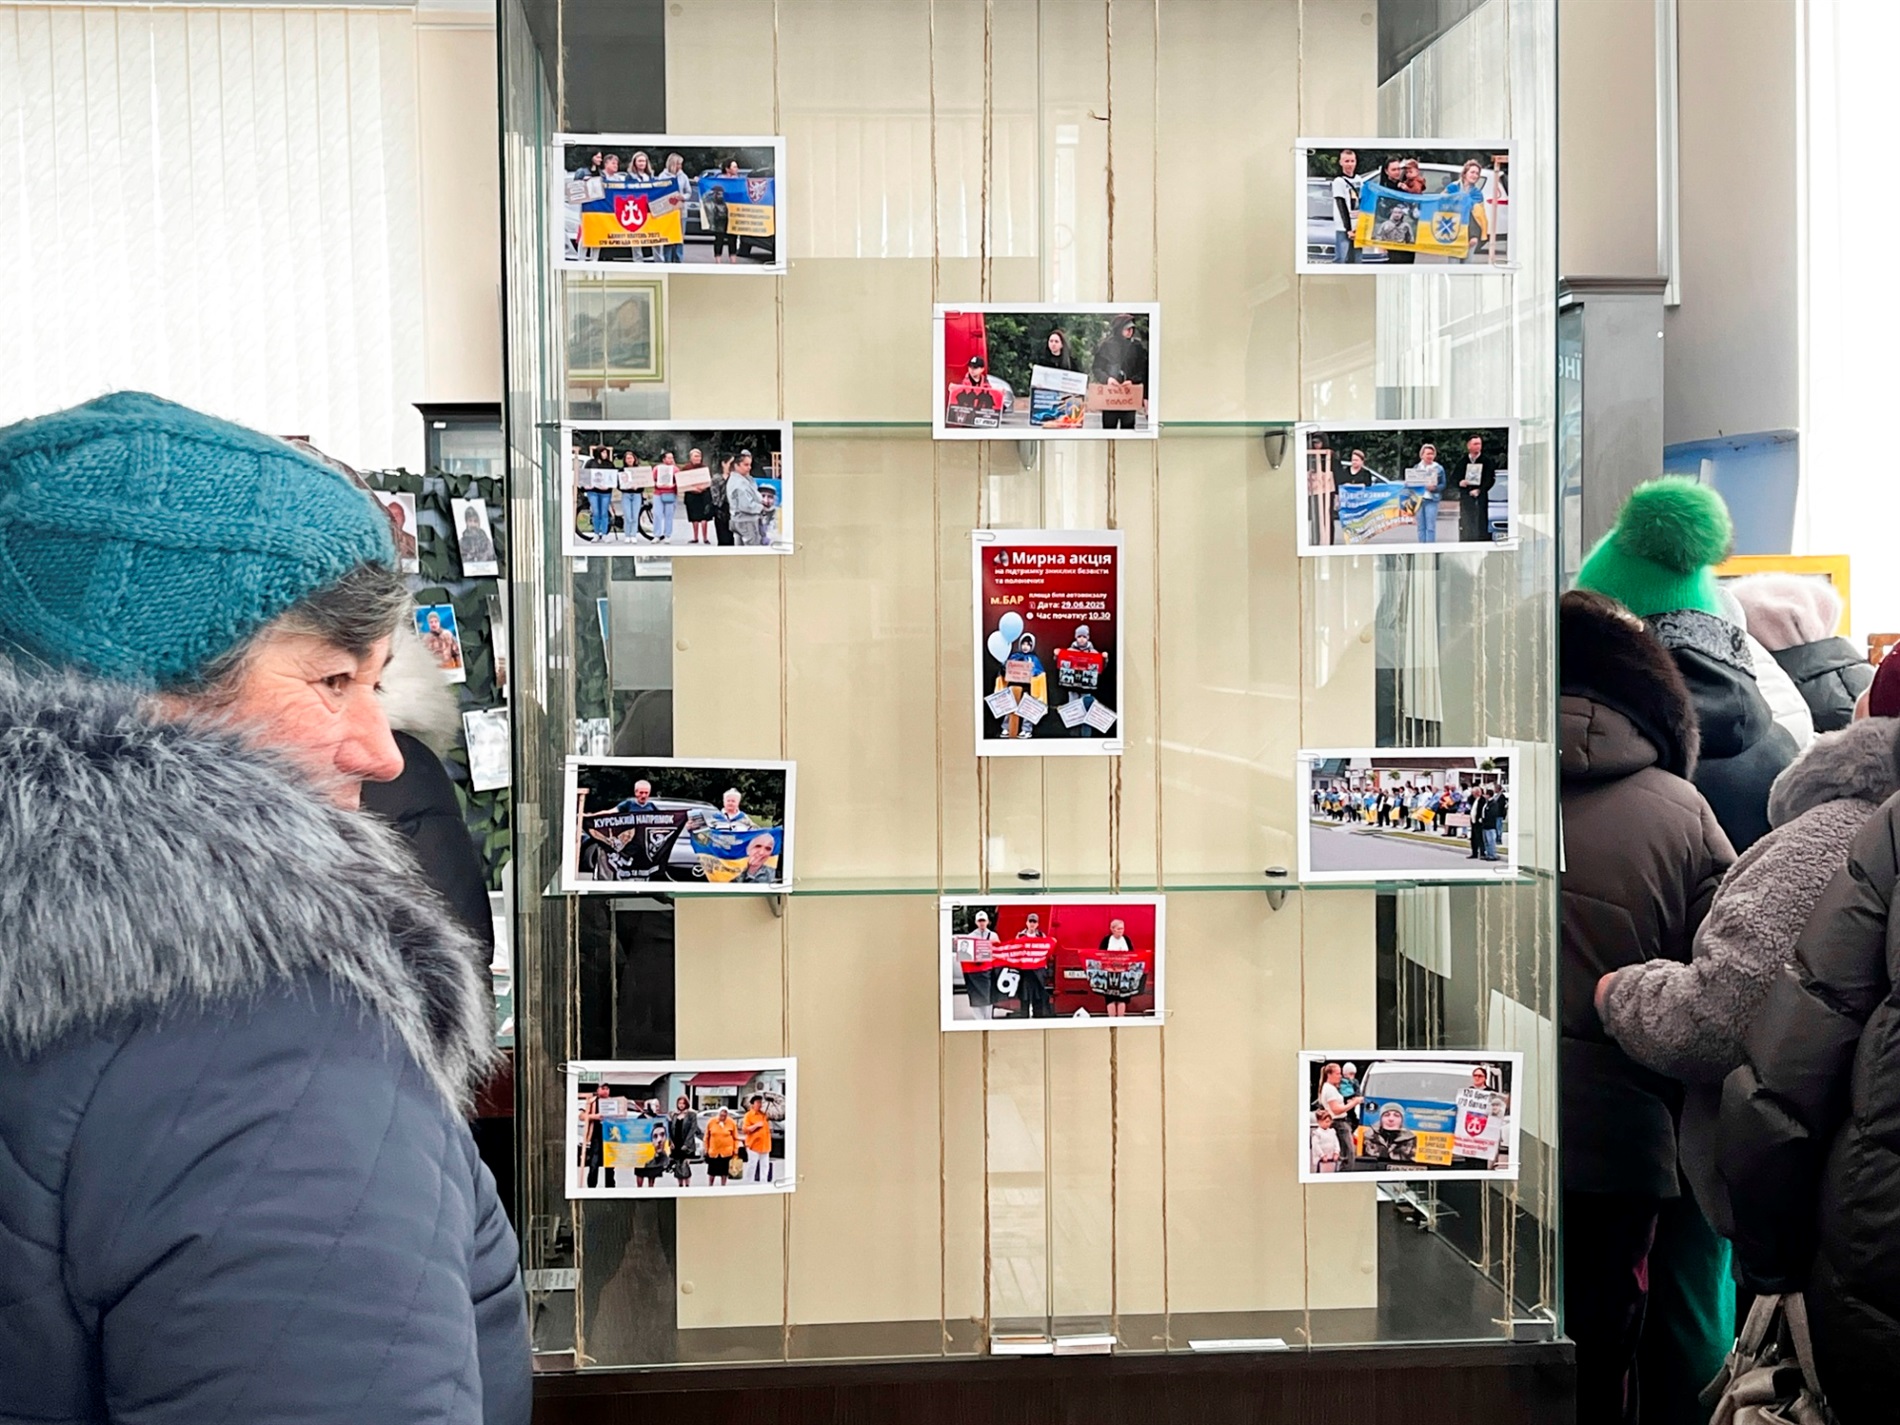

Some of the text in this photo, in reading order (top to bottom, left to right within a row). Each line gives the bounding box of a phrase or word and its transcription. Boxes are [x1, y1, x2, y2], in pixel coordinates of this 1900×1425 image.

[1012, 552, 1112, 567] Мирна акція
[1005, 568, 1044, 576] підтримку
[1077, 567, 1110, 575] безвісти
[990, 595, 1024, 605] м.БАР
[1037, 601, 1060, 610] Дата:
[1036, 612, 1111, 621] Час початку: 10.30
[593, 814, 675, 828] КУРСЬКИЙ НАПРЯМОК
